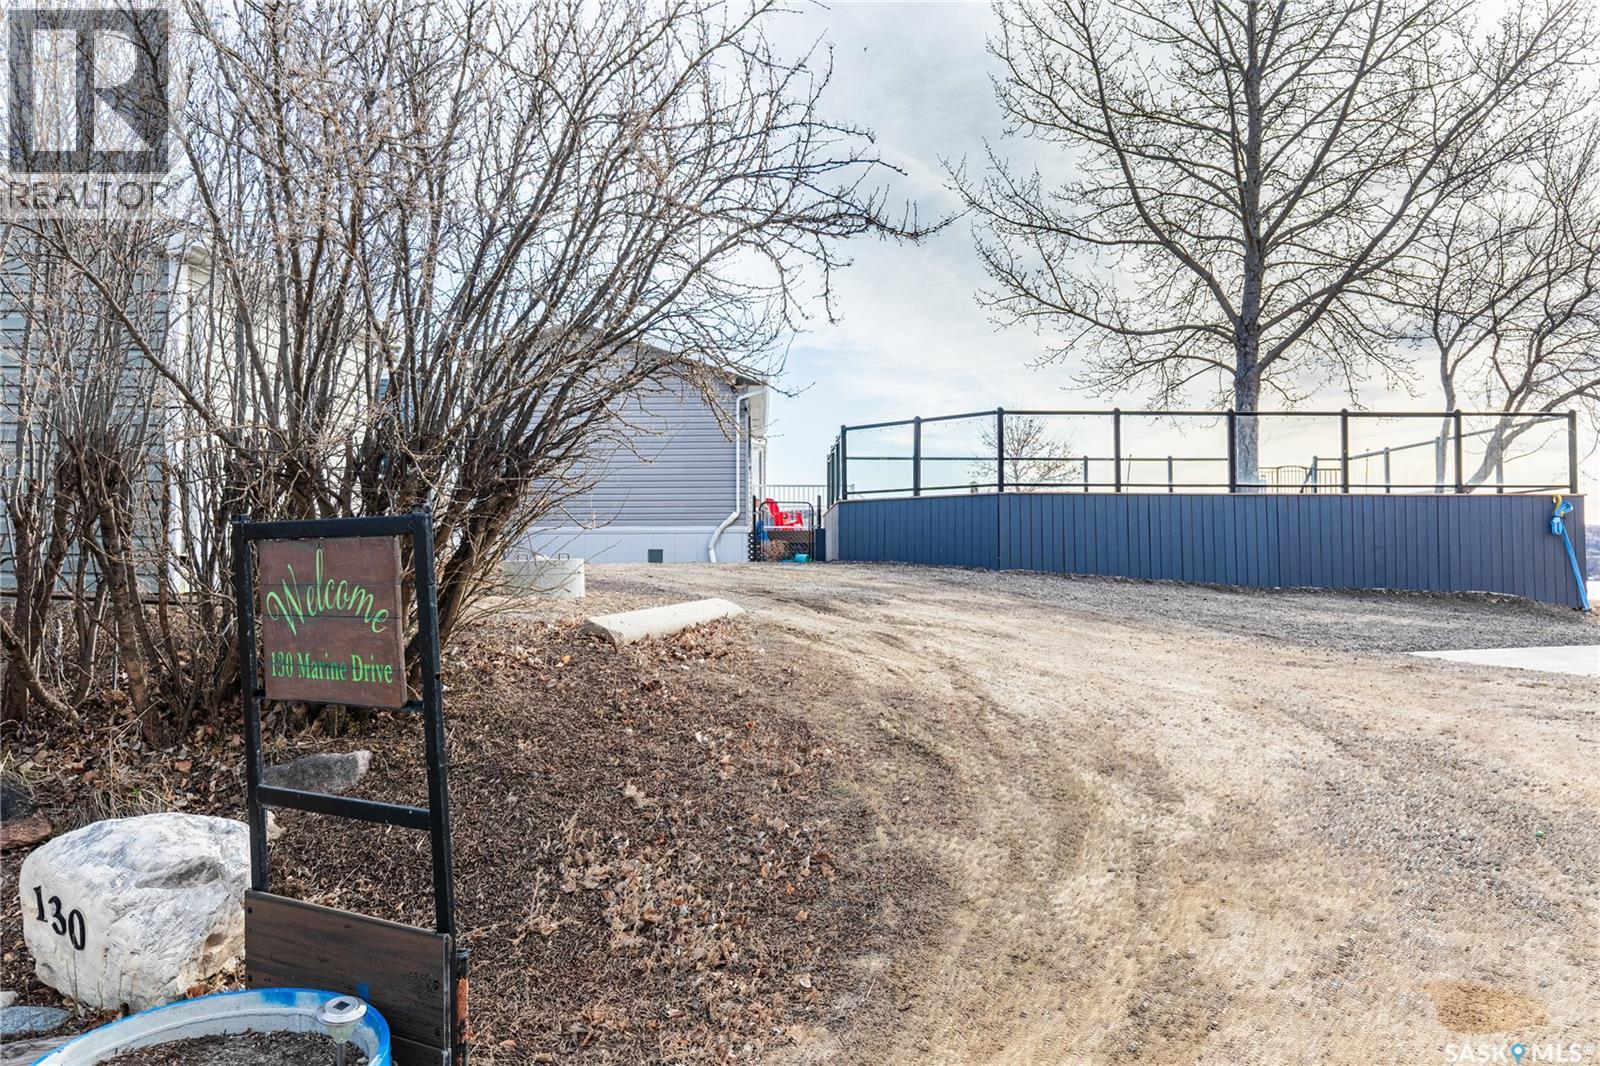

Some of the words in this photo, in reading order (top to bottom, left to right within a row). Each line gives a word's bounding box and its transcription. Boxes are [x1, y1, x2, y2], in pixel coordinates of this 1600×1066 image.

[266, 548, 389, 636] Welcome
[271, 652, 293, 678] 130
[298, 652, 347, 681] Marine
[351, 654, 393, 683] Drive
[33, 885, 86, 951] 130
